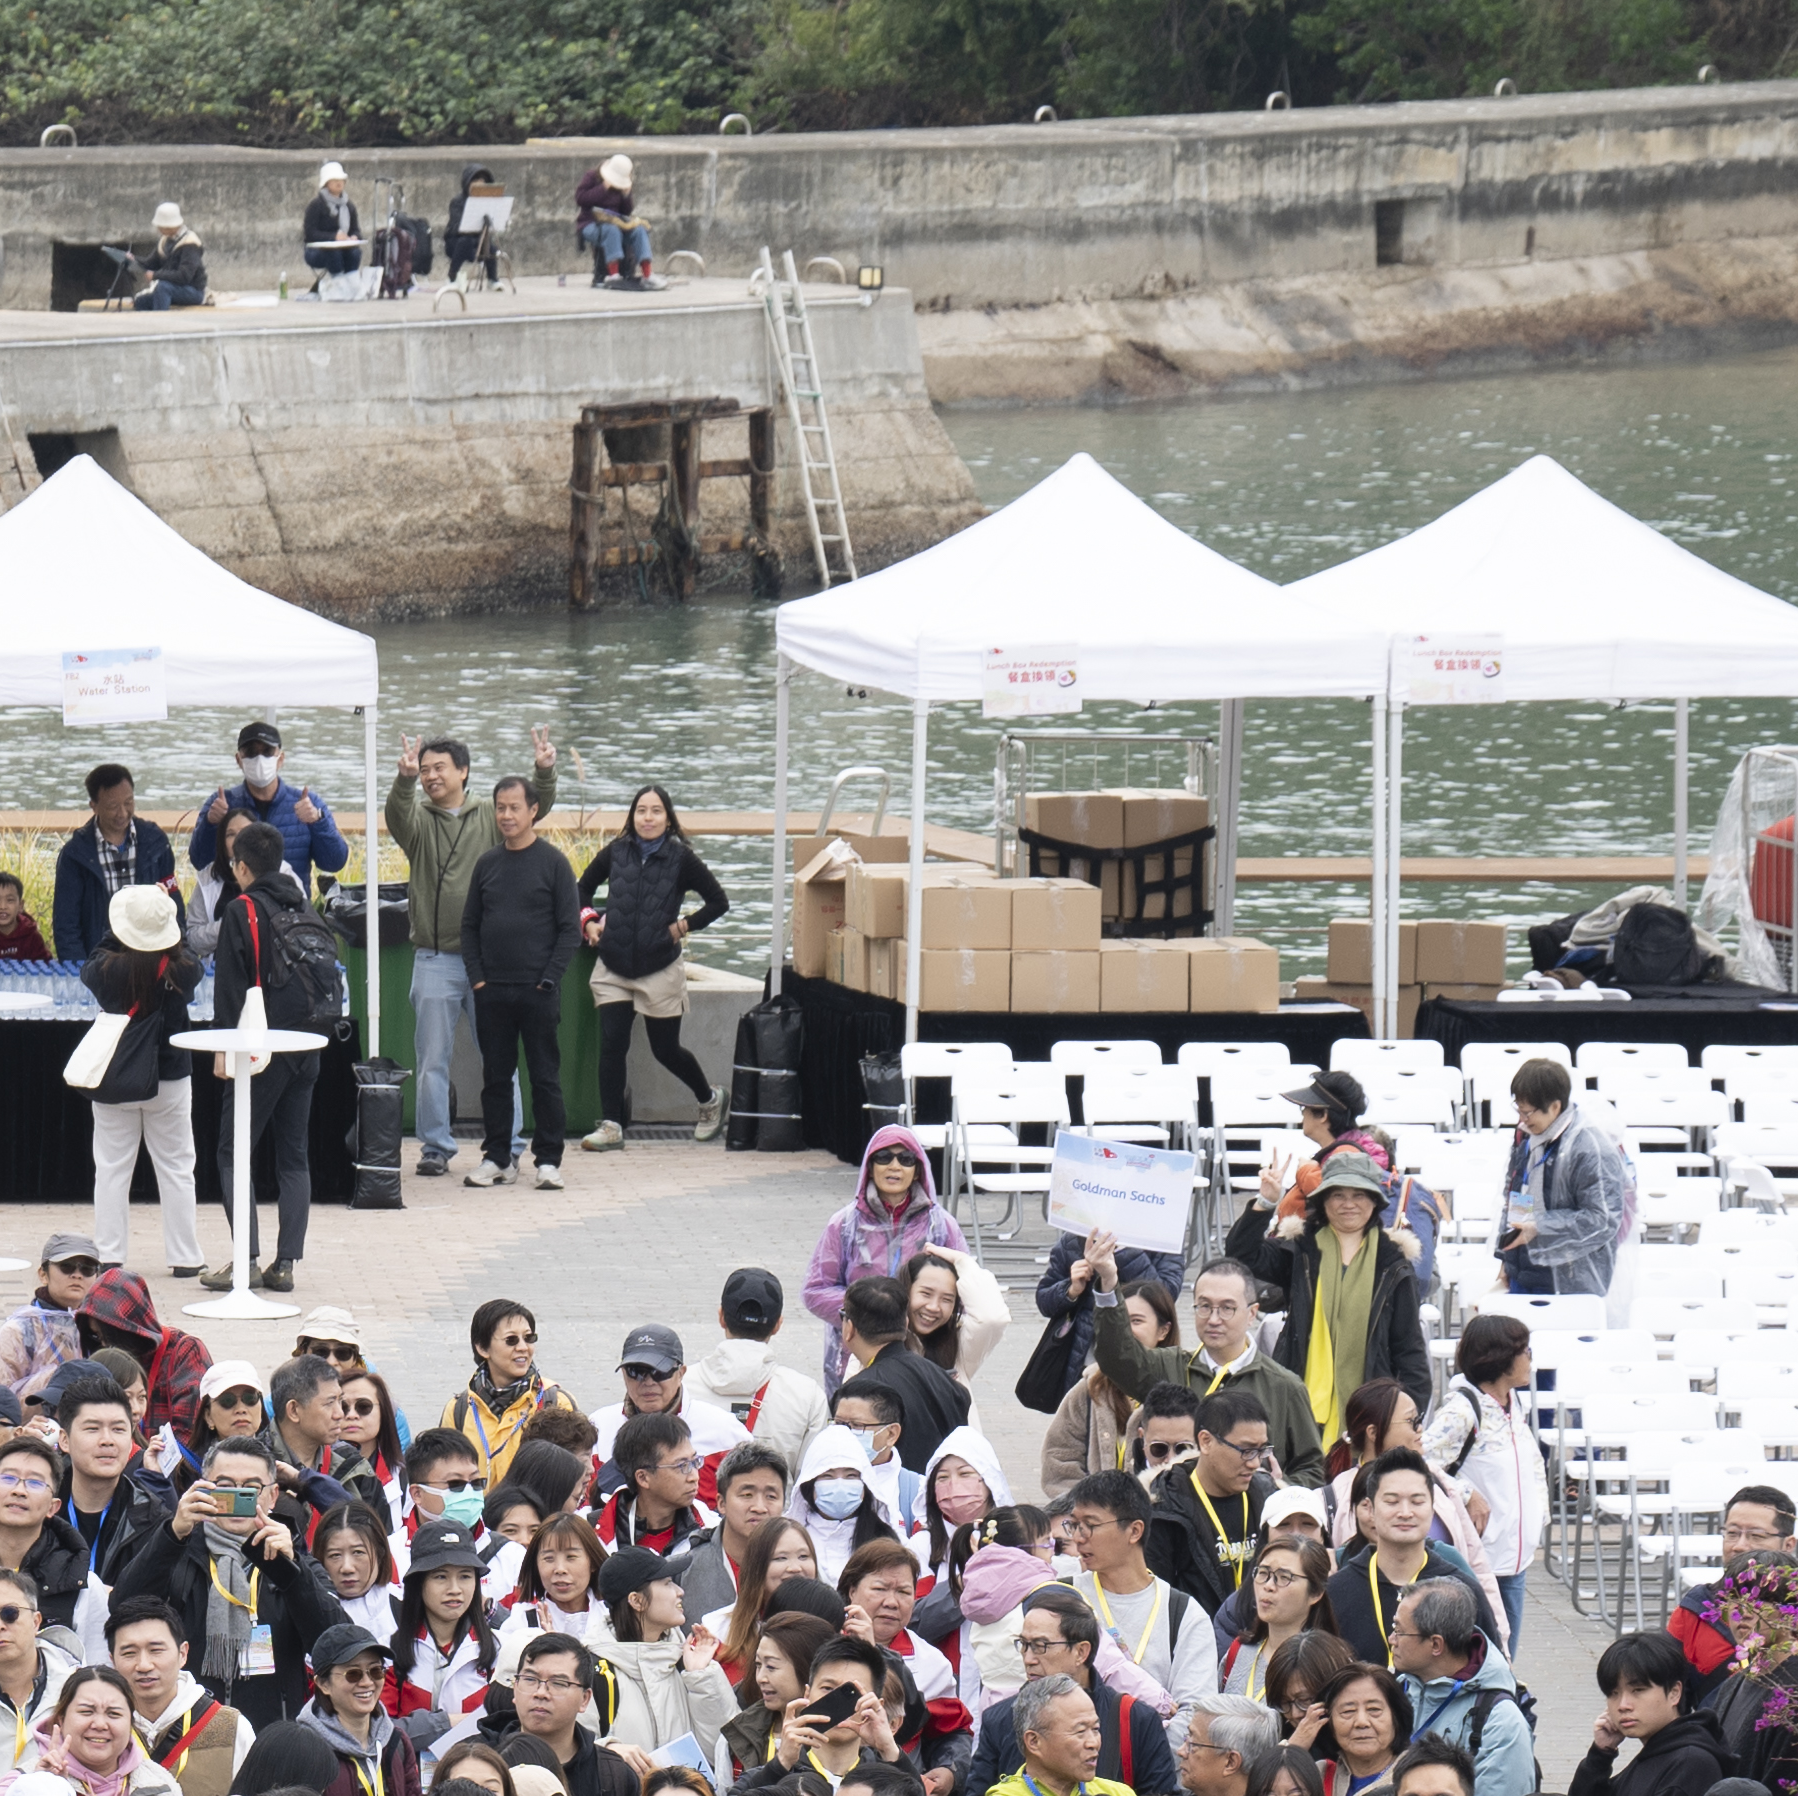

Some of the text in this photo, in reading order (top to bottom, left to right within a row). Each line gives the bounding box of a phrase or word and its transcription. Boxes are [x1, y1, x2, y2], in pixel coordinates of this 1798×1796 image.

[102, 674, 125, 685] 水站
[78, 684, 151, 696] Water Station
[1072, 1179, 1166, 1206] Goldman Sachs
